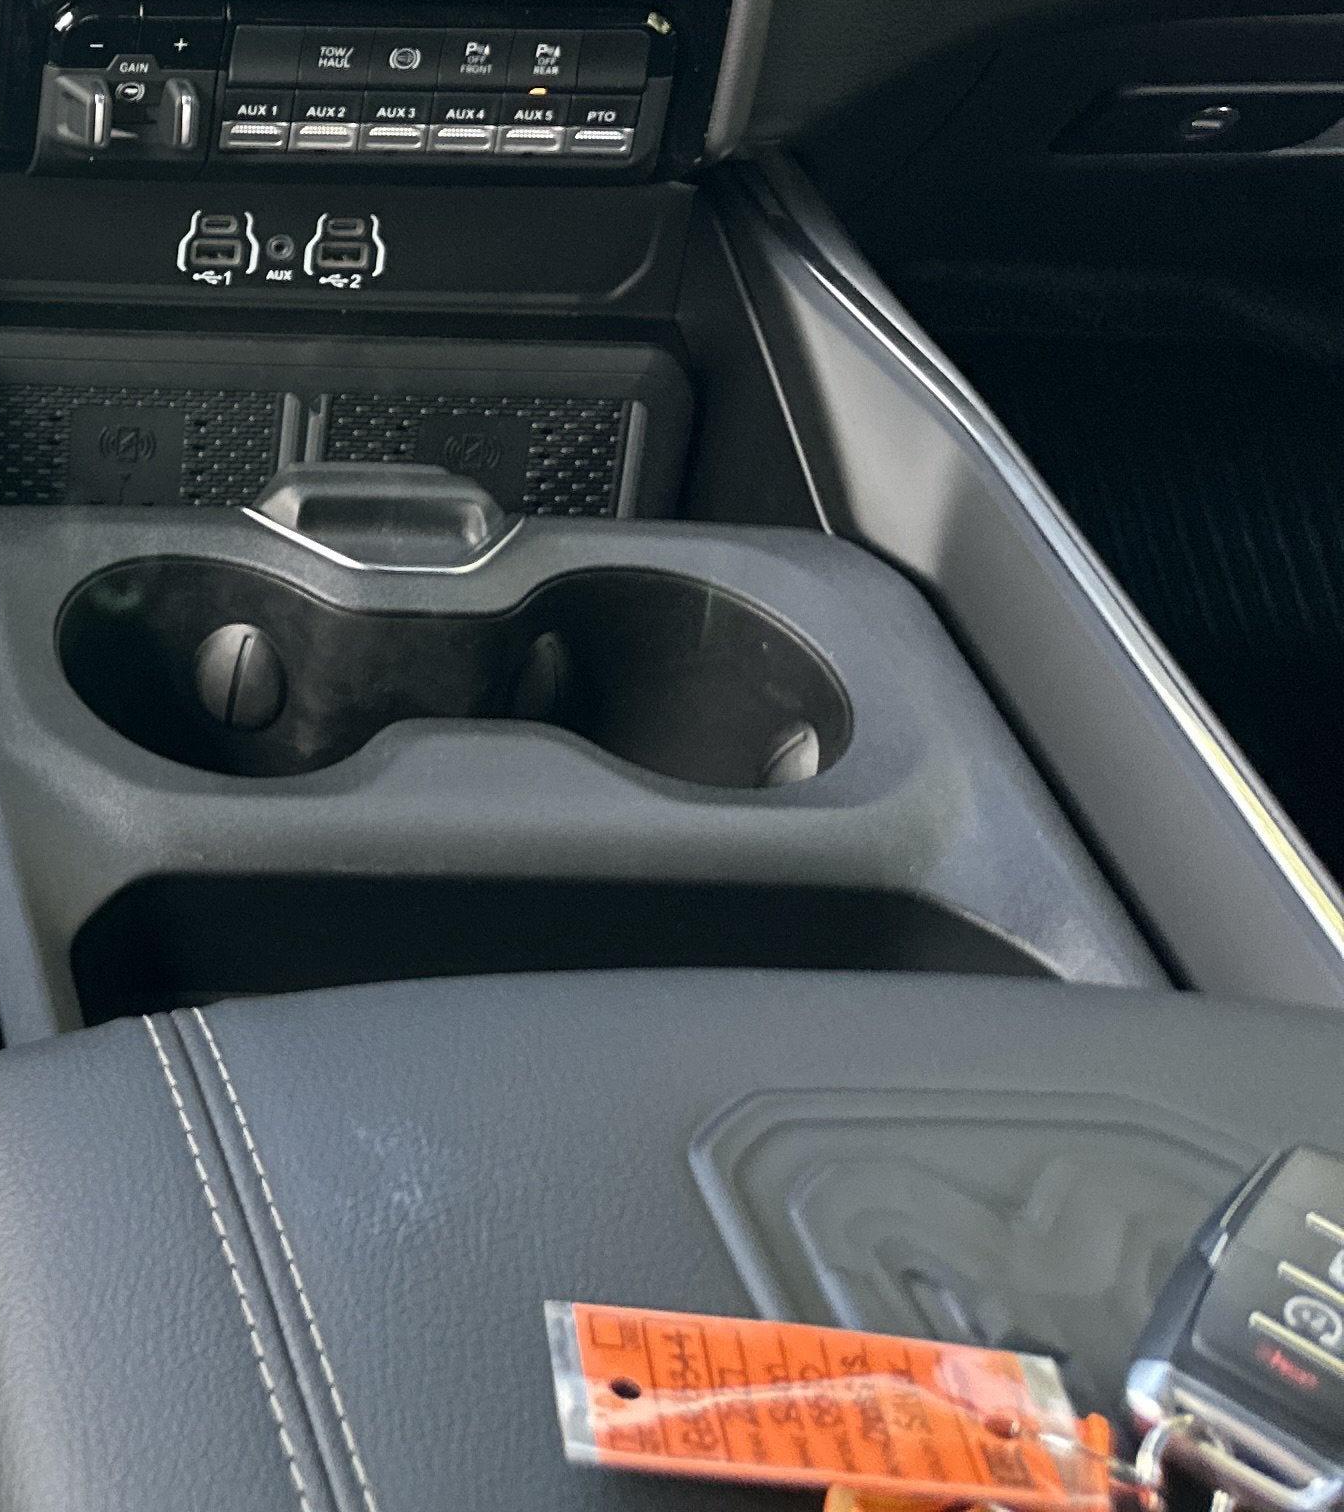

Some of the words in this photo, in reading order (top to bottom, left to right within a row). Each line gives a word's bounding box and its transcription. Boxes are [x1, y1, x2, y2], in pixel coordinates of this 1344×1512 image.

[319, 45, 355, 59] TOW/
[317, 57, 351, 69] HAUL
[466, 55, 486, 64] OFF
[537, 57, 557, 66] OFF
[119, 62, 150, 74] GAIN
[460, 63, 493, 75] FRONT
[532, 65, 560, 76] REAR
[237, 104, 268, 117] AUX
[272, 105, 278, 116] 1
[306, 106, 336, 118] AUX
[337, 106, 347, 118] 2
[376, 107, 406, 119] AUX
[407, 107, 416, 119] 3
[445, 108, 475, 120] AUX
[475, 108, 485, 120] 4
[514, 109, 544, 121] AUX
[544, 109, 554, 121] 5
[586, 110, 617, 122] PTO
[223, 271, 232, 286] 1
[265, 269, 293, 281] AUX
[349, 274, 362, 289] 2
